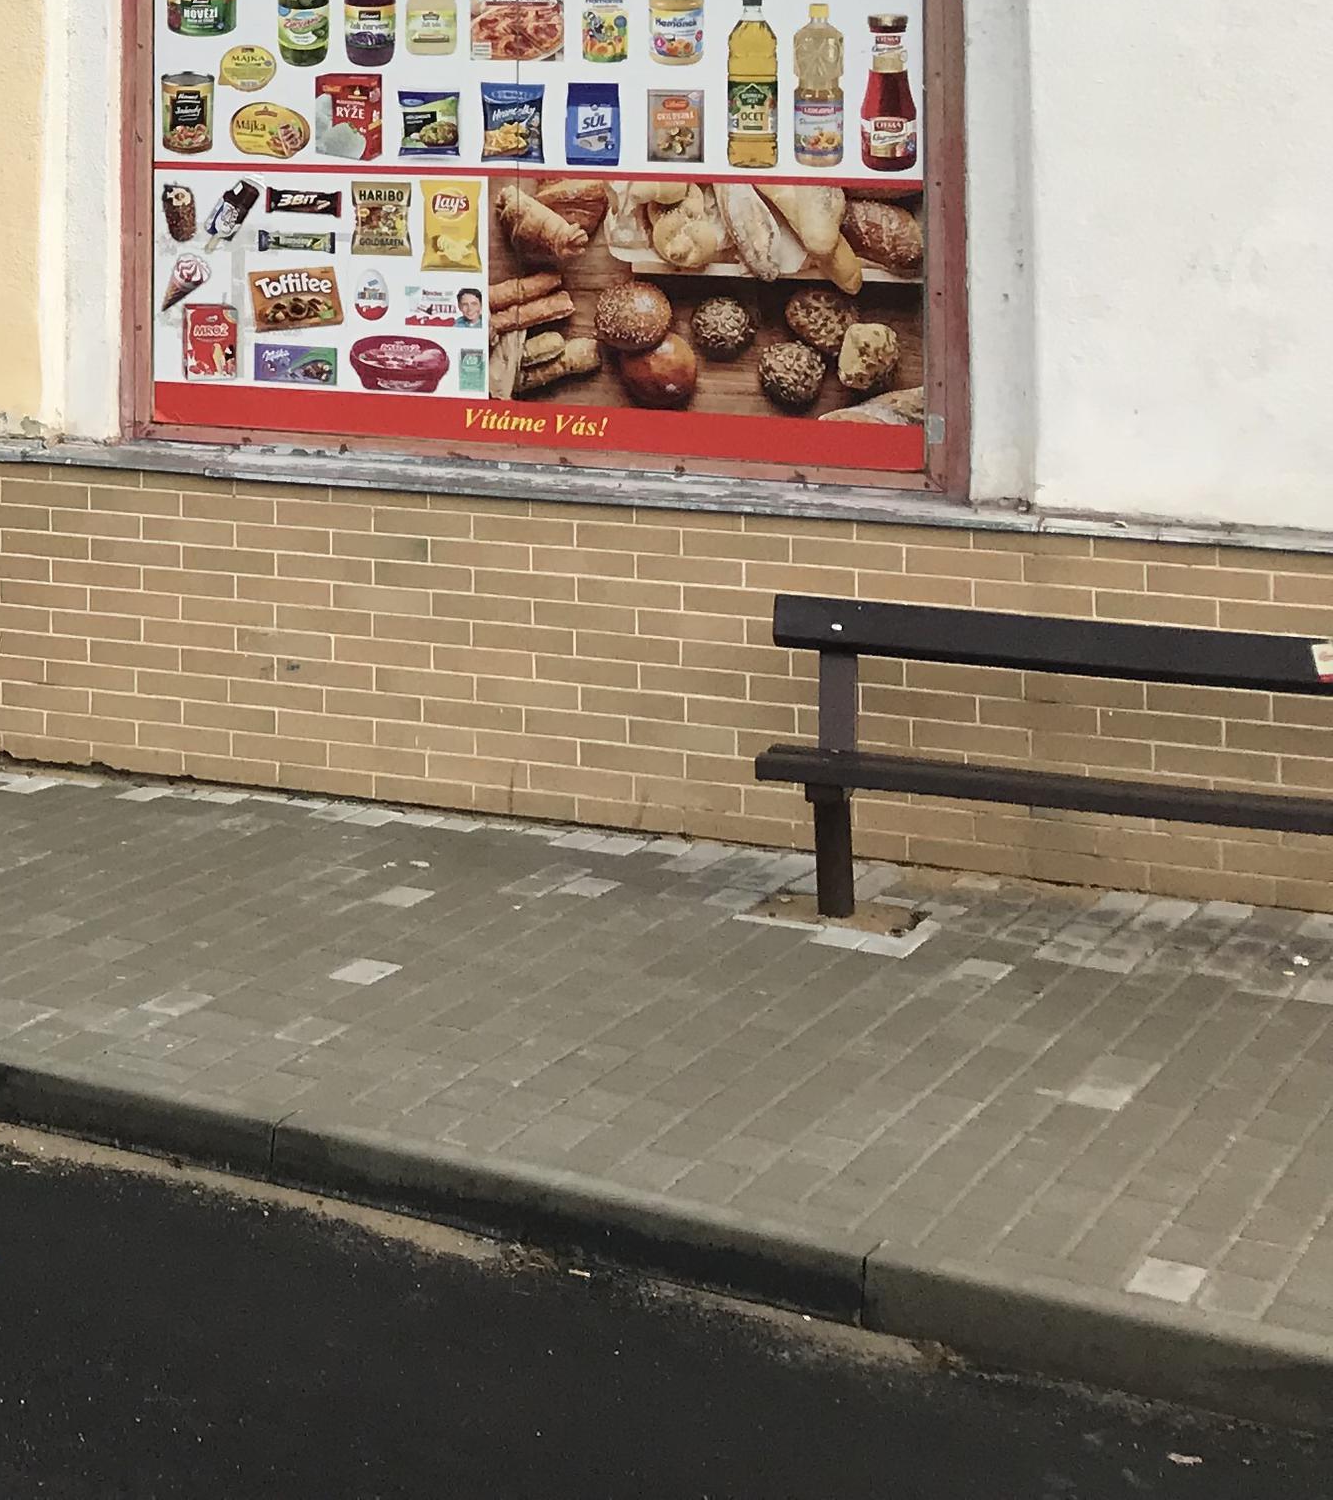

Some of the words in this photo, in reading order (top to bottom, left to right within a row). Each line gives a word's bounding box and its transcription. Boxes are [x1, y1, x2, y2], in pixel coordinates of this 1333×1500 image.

[741, 111, 765, 121] OCET
[359, 190, 404, 202] HARIBO
[255, 271, 333, 299] Toffifee
[465, 408, 546, 433] Vítáme
[555, 414, 609, 437] Vás!
